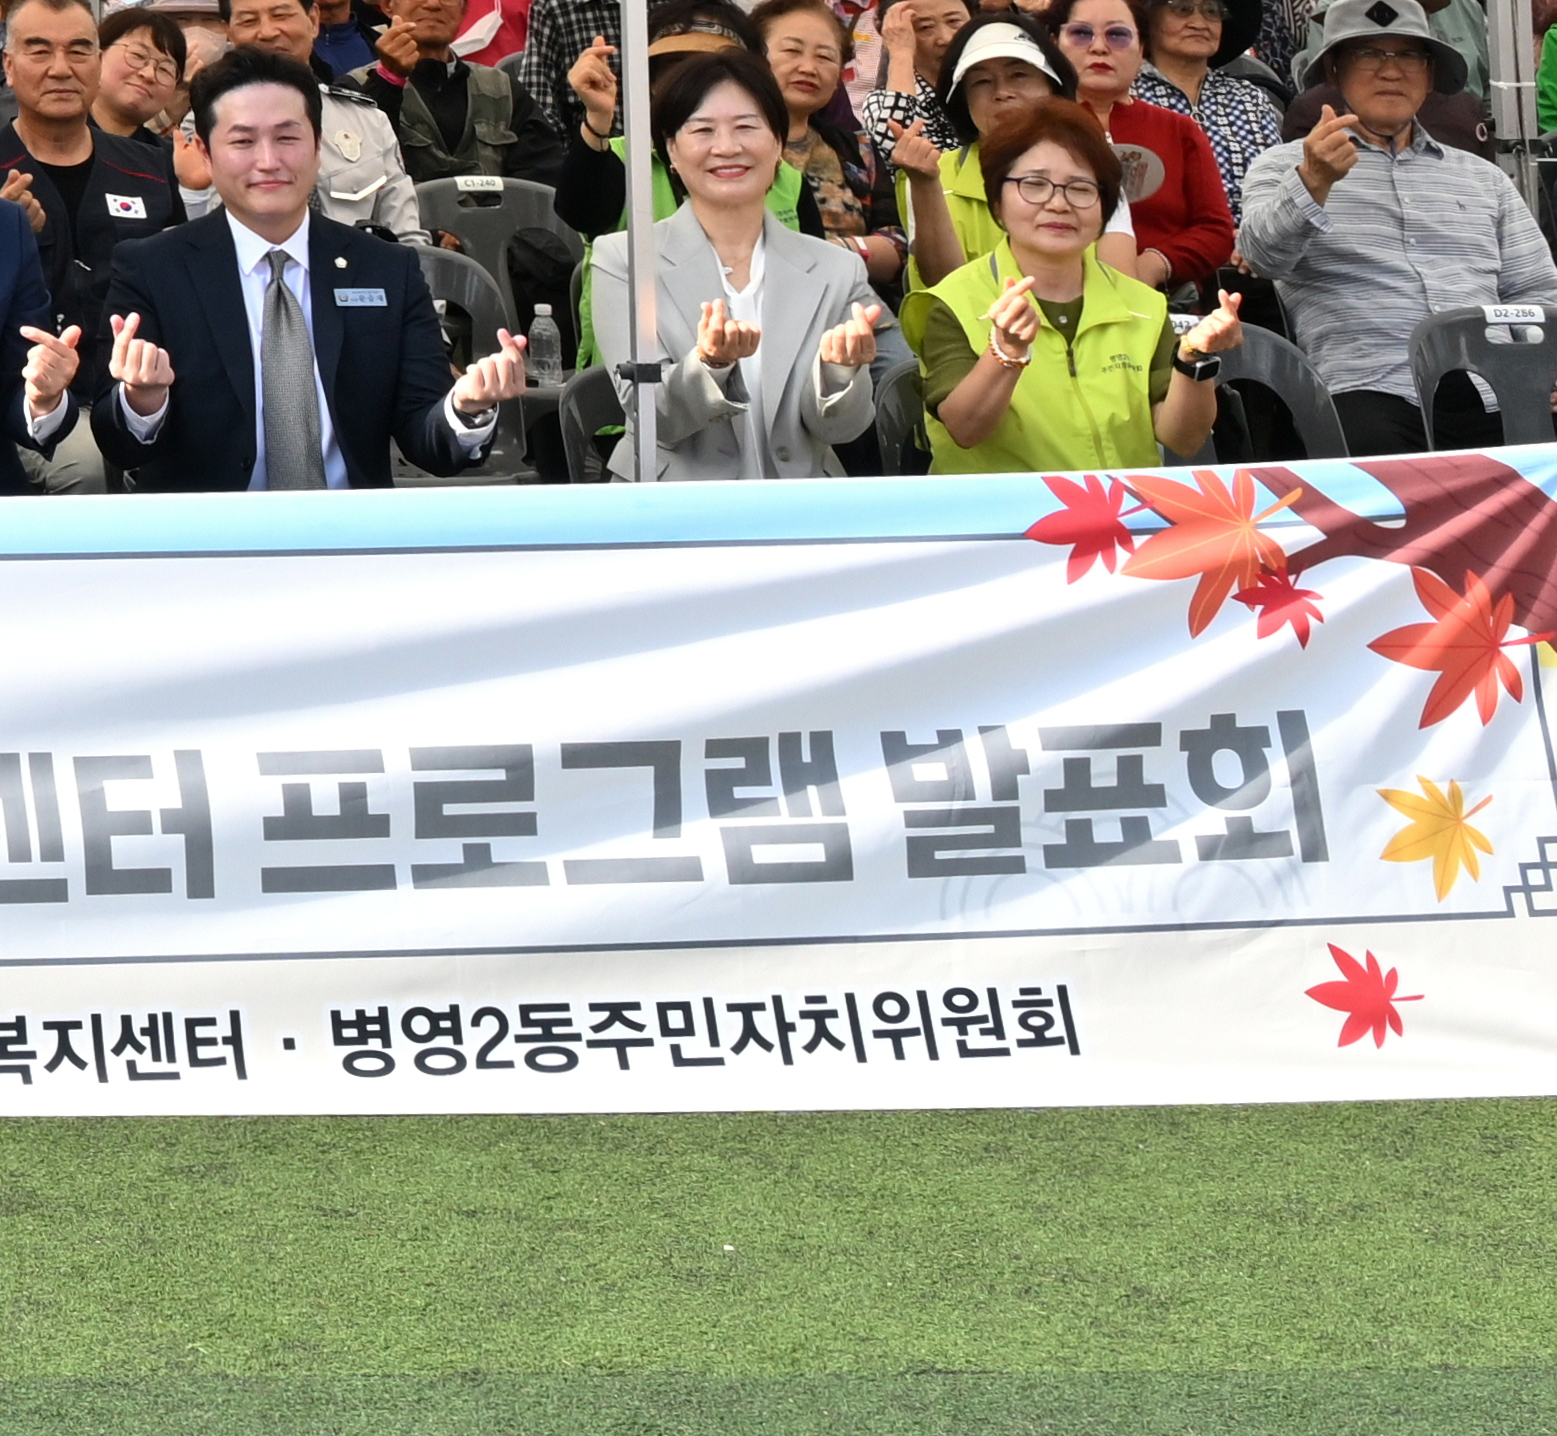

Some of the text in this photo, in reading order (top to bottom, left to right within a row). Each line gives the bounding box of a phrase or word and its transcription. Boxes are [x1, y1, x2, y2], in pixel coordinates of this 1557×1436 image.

[463, 178, 497, 189] C1-240
[1493, 307, 1535, 319] D2-286
[256, 729, 855, 894] 프로그램
[880, 708, 1330, 880] 발표회
[330, 984, 1082, 1078] 병영2동주민자치위원회
